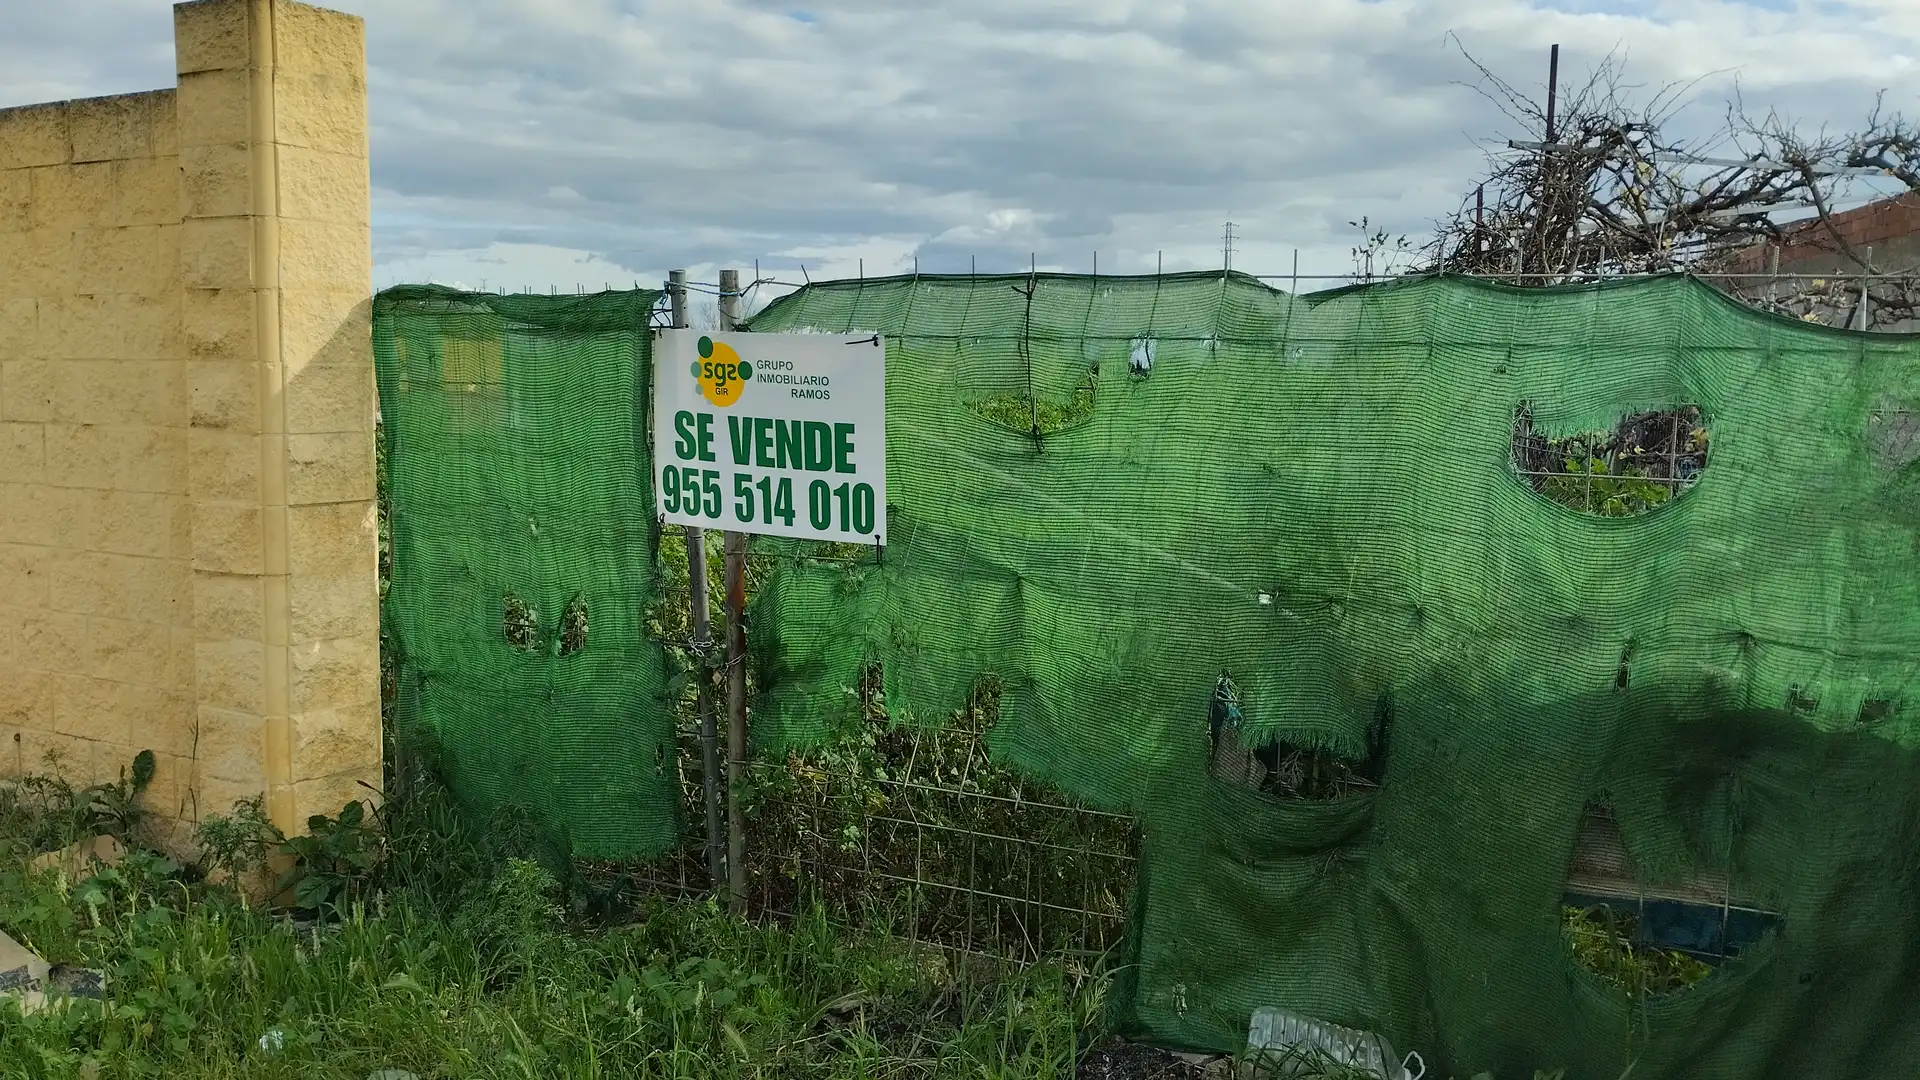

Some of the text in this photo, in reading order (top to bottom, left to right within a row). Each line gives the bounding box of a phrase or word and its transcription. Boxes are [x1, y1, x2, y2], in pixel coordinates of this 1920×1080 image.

[756, 360, 794, 371] GRUPO
[757, 374, 830, 386] INMOBILIARIO
[715, 388, 729, 396] GIR
[791, 389, 830, 400] RAMOS
[674, 410, 856, 474] SE VENDE
[663, 465, 875, 535] 955 514 010
